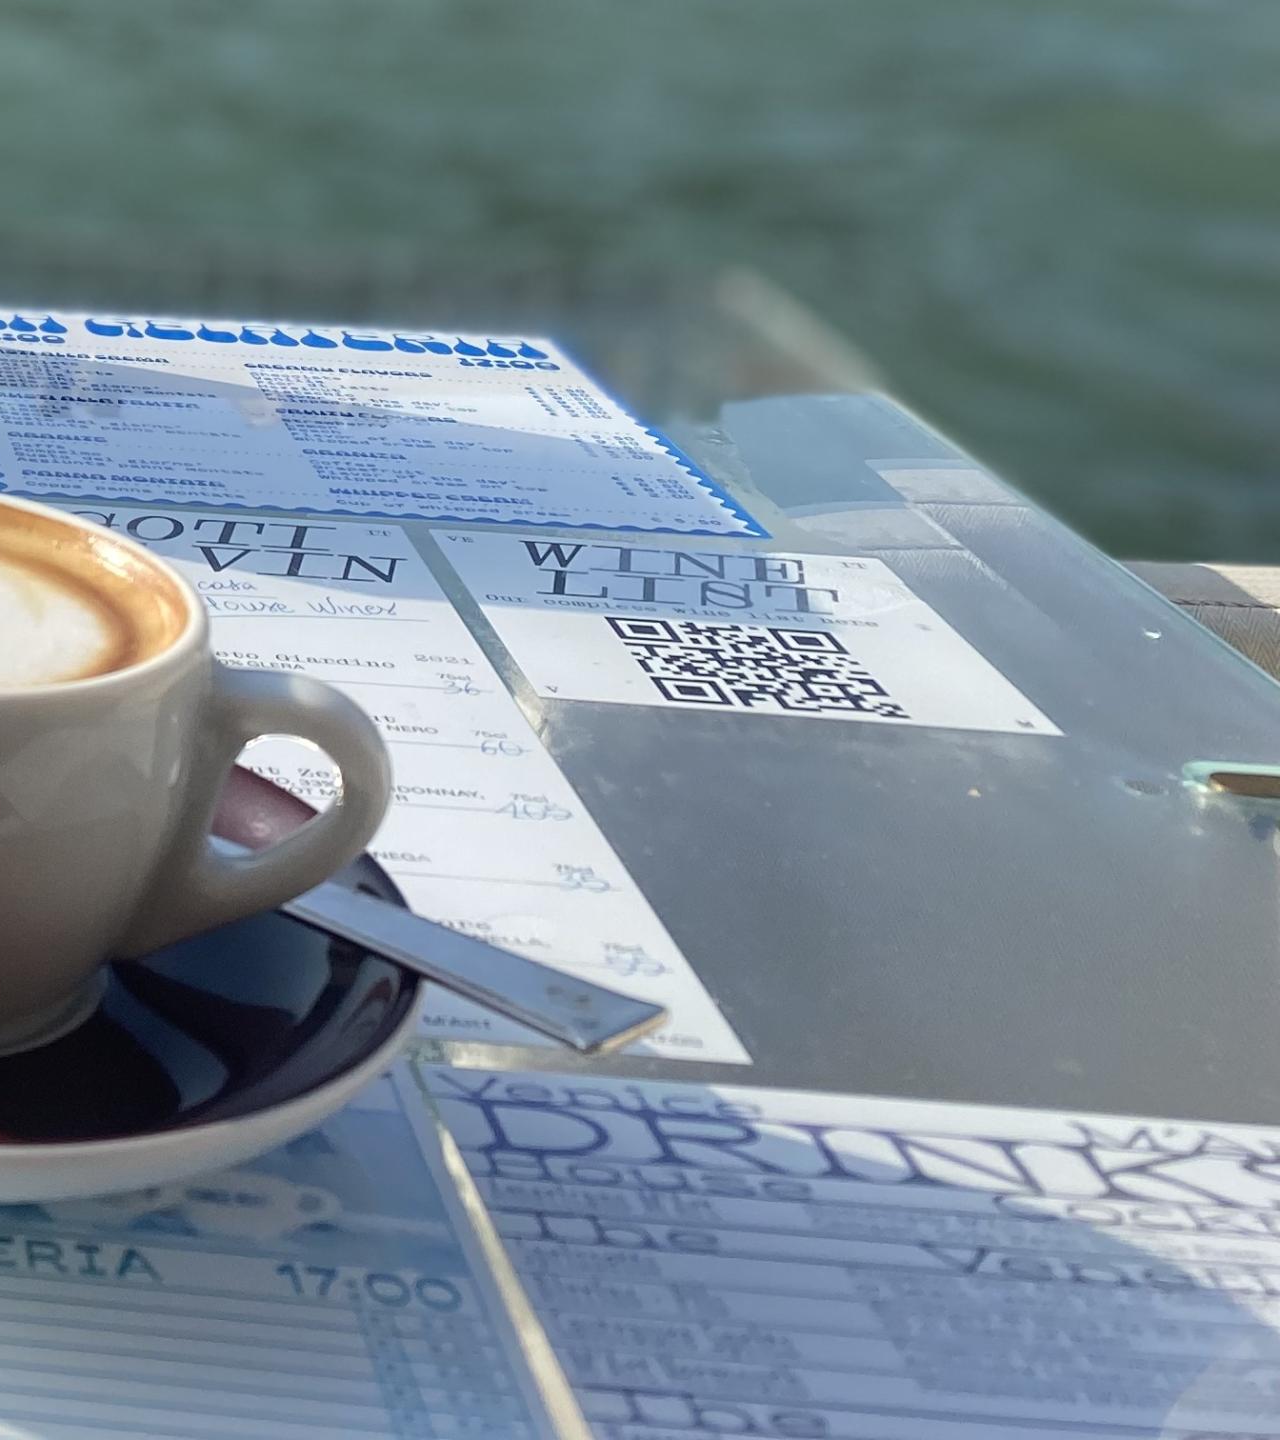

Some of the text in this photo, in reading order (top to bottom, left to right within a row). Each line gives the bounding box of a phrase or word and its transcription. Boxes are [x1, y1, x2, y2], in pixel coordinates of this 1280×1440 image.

[192, 543, 408, 584] VIN
[518, 539, 806, 585] WINE
[537, 567, 840, 615] LIST
[543, 597, 659, 615] complete
[275, 1264, 464, 1313] 17:00
